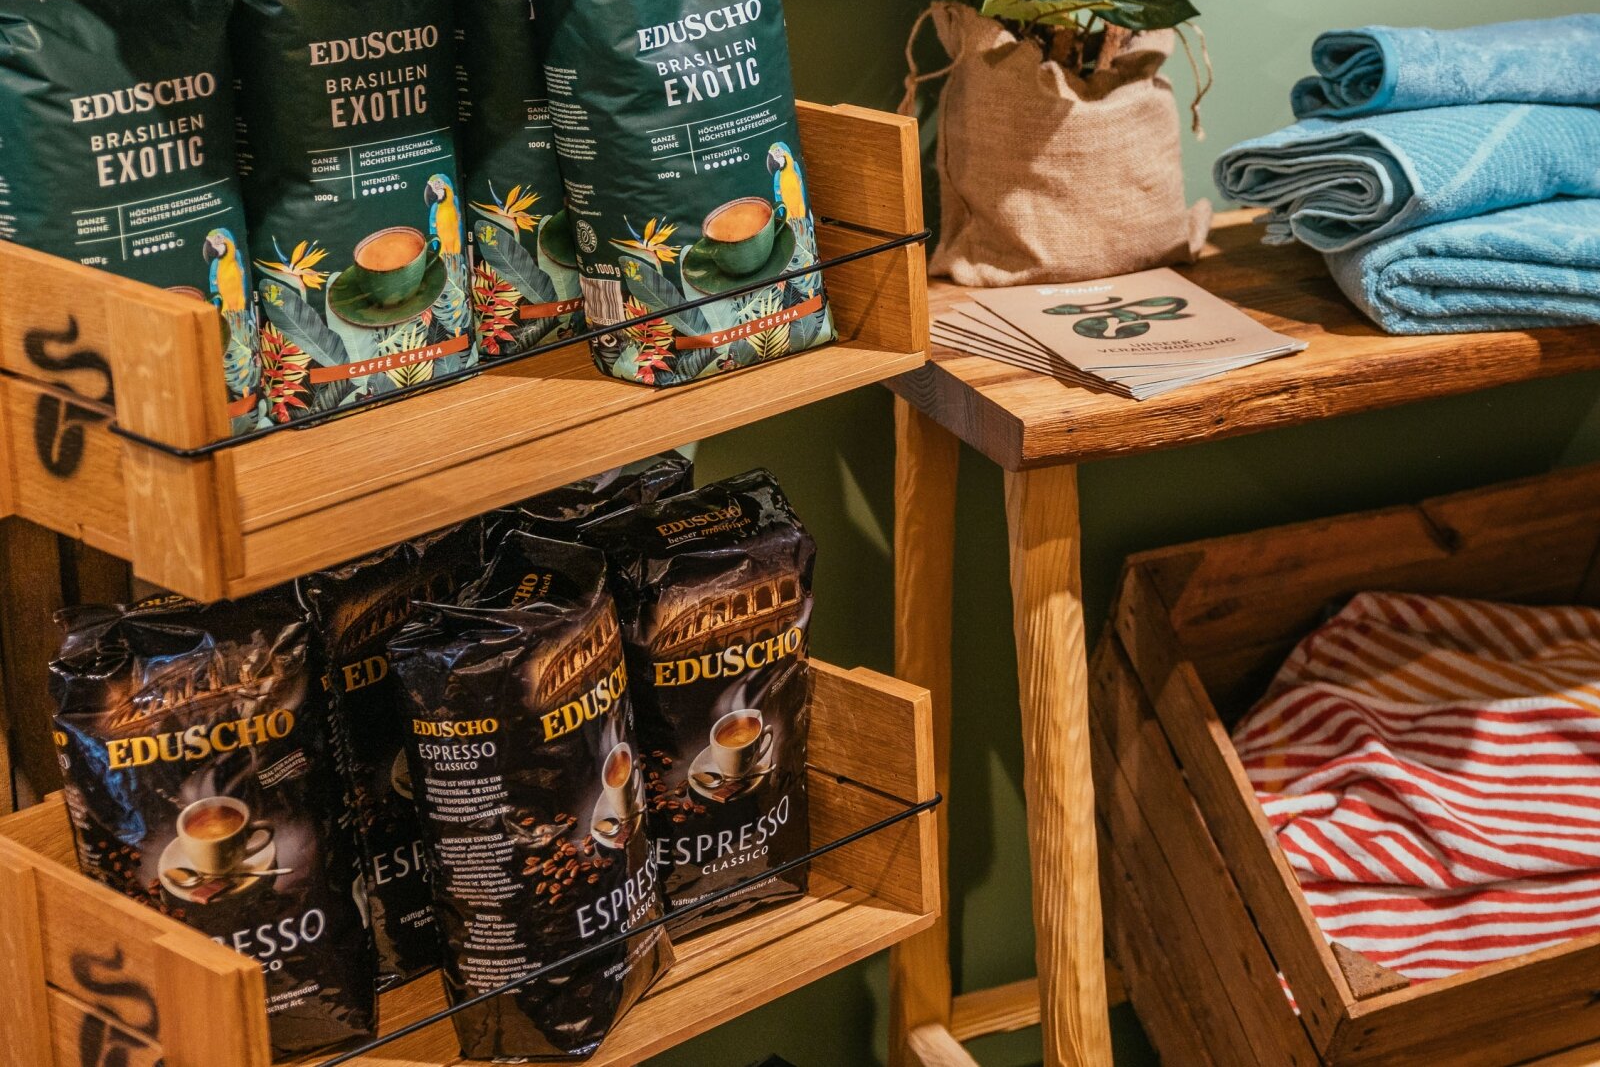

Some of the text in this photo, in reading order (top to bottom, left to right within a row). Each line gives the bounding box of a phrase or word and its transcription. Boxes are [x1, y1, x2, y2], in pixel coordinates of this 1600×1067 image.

[308, 24, 439, 66] EDUSCHO
[656, 37, 758, 77] BRASILIEN
[326, 64, 428, 94] BRASILIEN
[664, 57, 761, 107] EXOTIC
[70, 72, 217, 123] EDUSCHO
[330, 84, 427, 128] EXOTIC
[527, 113, 550, 121] BOHN
[697, 109, 770, 136] HÖCHSTER GESCHMACK
[699, 114, 778, 143] HÖCHSTER KAFFEEGENUSS
[90, 114, 206, 152] BRASILIEN
[651, 134, 676, 145] GANZE
[652, 141, 680, 152] BOHNE
[96, 136, 204, 188] EXOTIC
[311, 156, 339, 165] GANZE
[359, 139, 434, 159] HÖCHSTER GESCHMACK
[360, 145, 442, 167] HÖCHSTER KAFFEEGENUSS
[702, 146, 743, 162] INTENSITÄT:
[312, 164, 341, 173] BOHNE
[361, 174, 400, 187] INTENSITÄT:
[129, 192, 213, 218] HÖCHSTER GESCHMACK
[130, 197, 222, 227] HÖCHSTER KAFFEEGENUSS
[76, 216, 107, 227] GANZE
[77, 225, 110, 235] BOHNE
[556, 300, 584, 312] CAF
[711, 307, 800, 344] CAFFÈ CREMA
[1097, 336, 1237, 354] VERANTWORTUNG
[348, 346, 444, 376] CAFFÈ CREMA
[656, 505, 743, 537] EDUSCHO
[667, 531, 697, 545] besser
[653, 627, 802, 687] EDUSCHO
[540, 660, 628, 743] EDUSCH
[105, 709, 295, 771] EDUSCHO
[412, 718, 499, 737] EDUSCHO
[418, 741, 496, 760] ESPRESSO
[435, 761, 478, 772] CLASSICO
[656, 794, 789, 865] ESPRESSO
[701, 845, 769, 875] CLASSICO
[576, 843, 658, 938] ESPRESS
[413, 915, 434, 928] Espre
[620, 891, 656, 934] CLASSICO
[210, 908, 326, 958] ESSO
